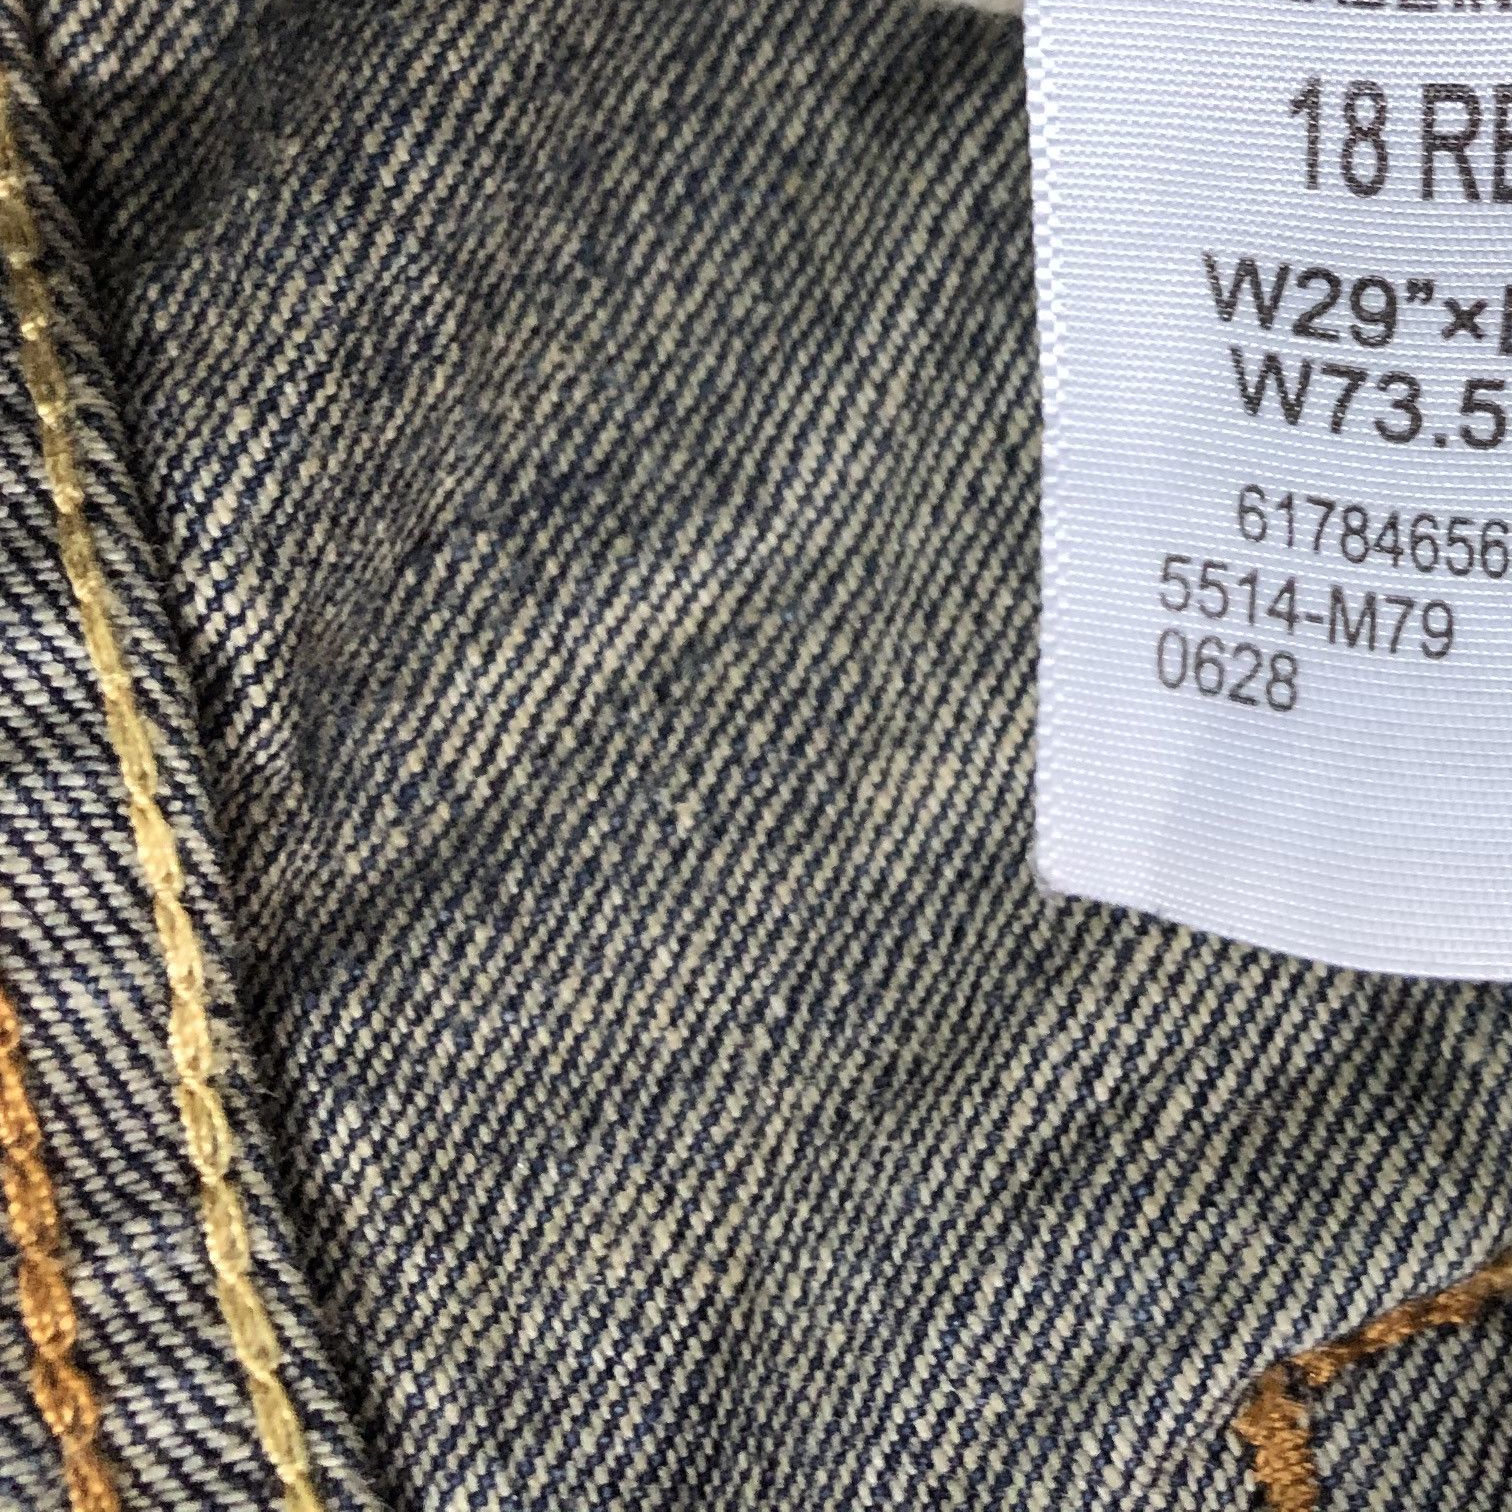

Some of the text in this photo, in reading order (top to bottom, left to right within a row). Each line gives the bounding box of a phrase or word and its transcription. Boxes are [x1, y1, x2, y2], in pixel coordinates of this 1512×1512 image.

[1289, 77, 1390, 198] 18
[1158, 554, 1455, 660] 5514-M79
[1155, 628, 1300, 714] 0628
